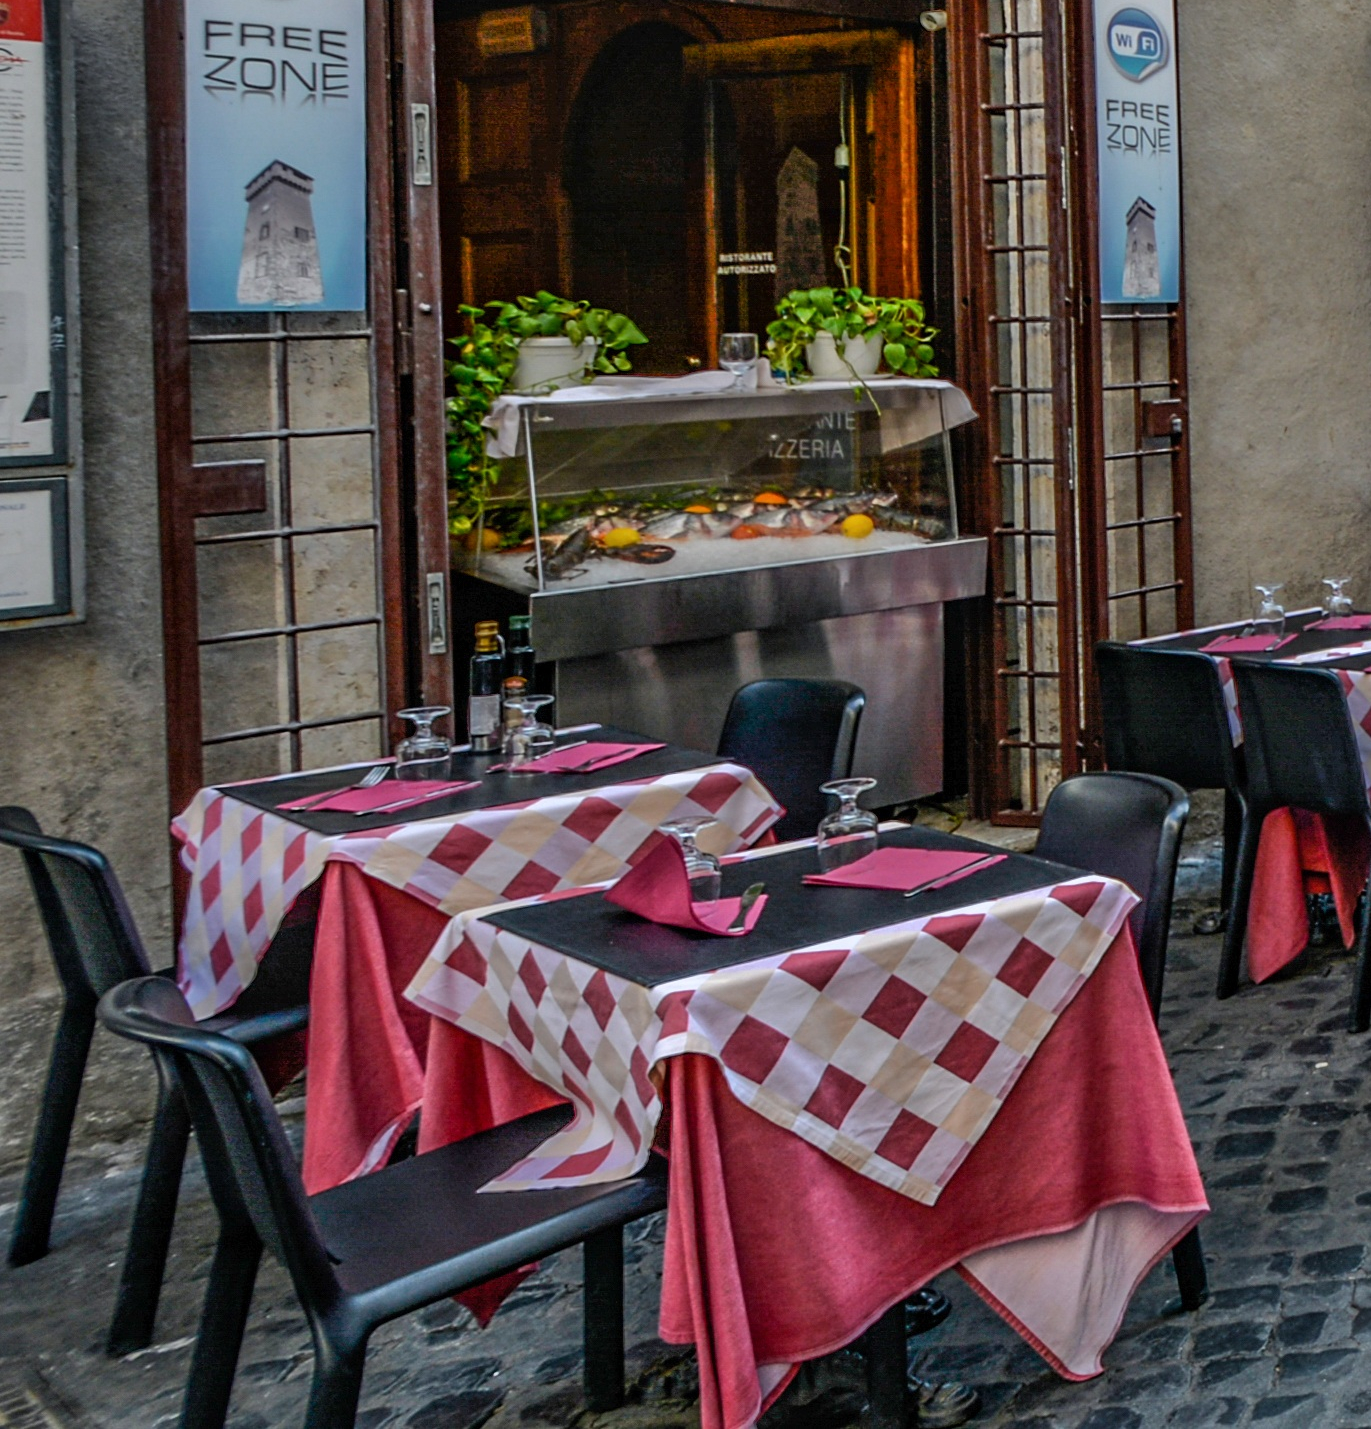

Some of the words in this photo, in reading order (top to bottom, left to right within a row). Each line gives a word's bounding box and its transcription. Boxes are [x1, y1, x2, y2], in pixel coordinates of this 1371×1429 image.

[204, 20, 348, 62] FREE
[203, 54, 349, 93] ZONE
[1106, 99, 1170, 127] FREE
[1106, 123, 1171, 150] ZONE
[717, 264, 777, 276] AUTORIZZATO
[718, 251, 774, 263] RISTORANTE
